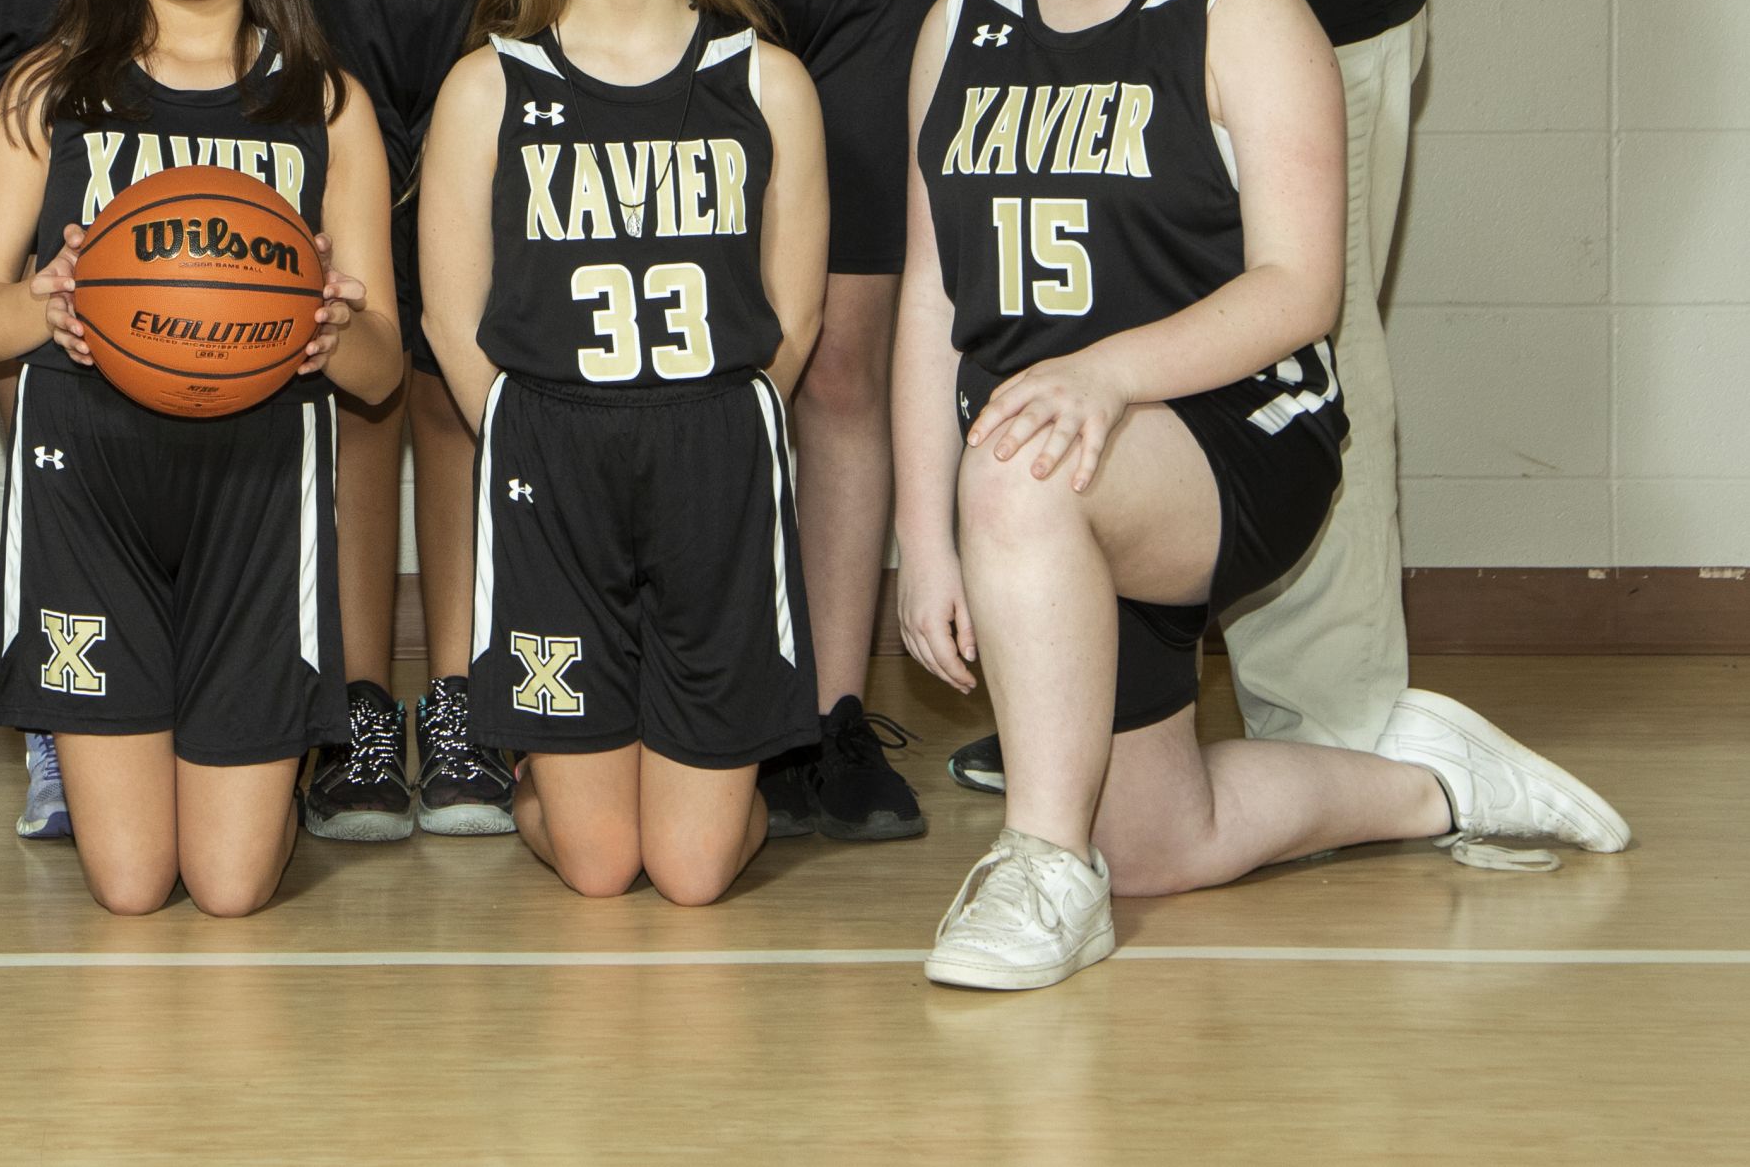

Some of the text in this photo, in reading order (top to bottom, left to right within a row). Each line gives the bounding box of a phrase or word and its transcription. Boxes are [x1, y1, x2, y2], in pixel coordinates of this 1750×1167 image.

[941, 81, 1154, 178] XAVIER
[521, 138, 747, 241] XAVIER
[132, 217, 300, 276] Wilson
[243, 265, 263, 273] BALL
[992, 197, 1094, 316] 15
[131, 310, 294, 343] EVOLUTION
[570, 262, 715, 382] 33
[40, 608, 106, 696] X
[510, 631, 584, 716] X
